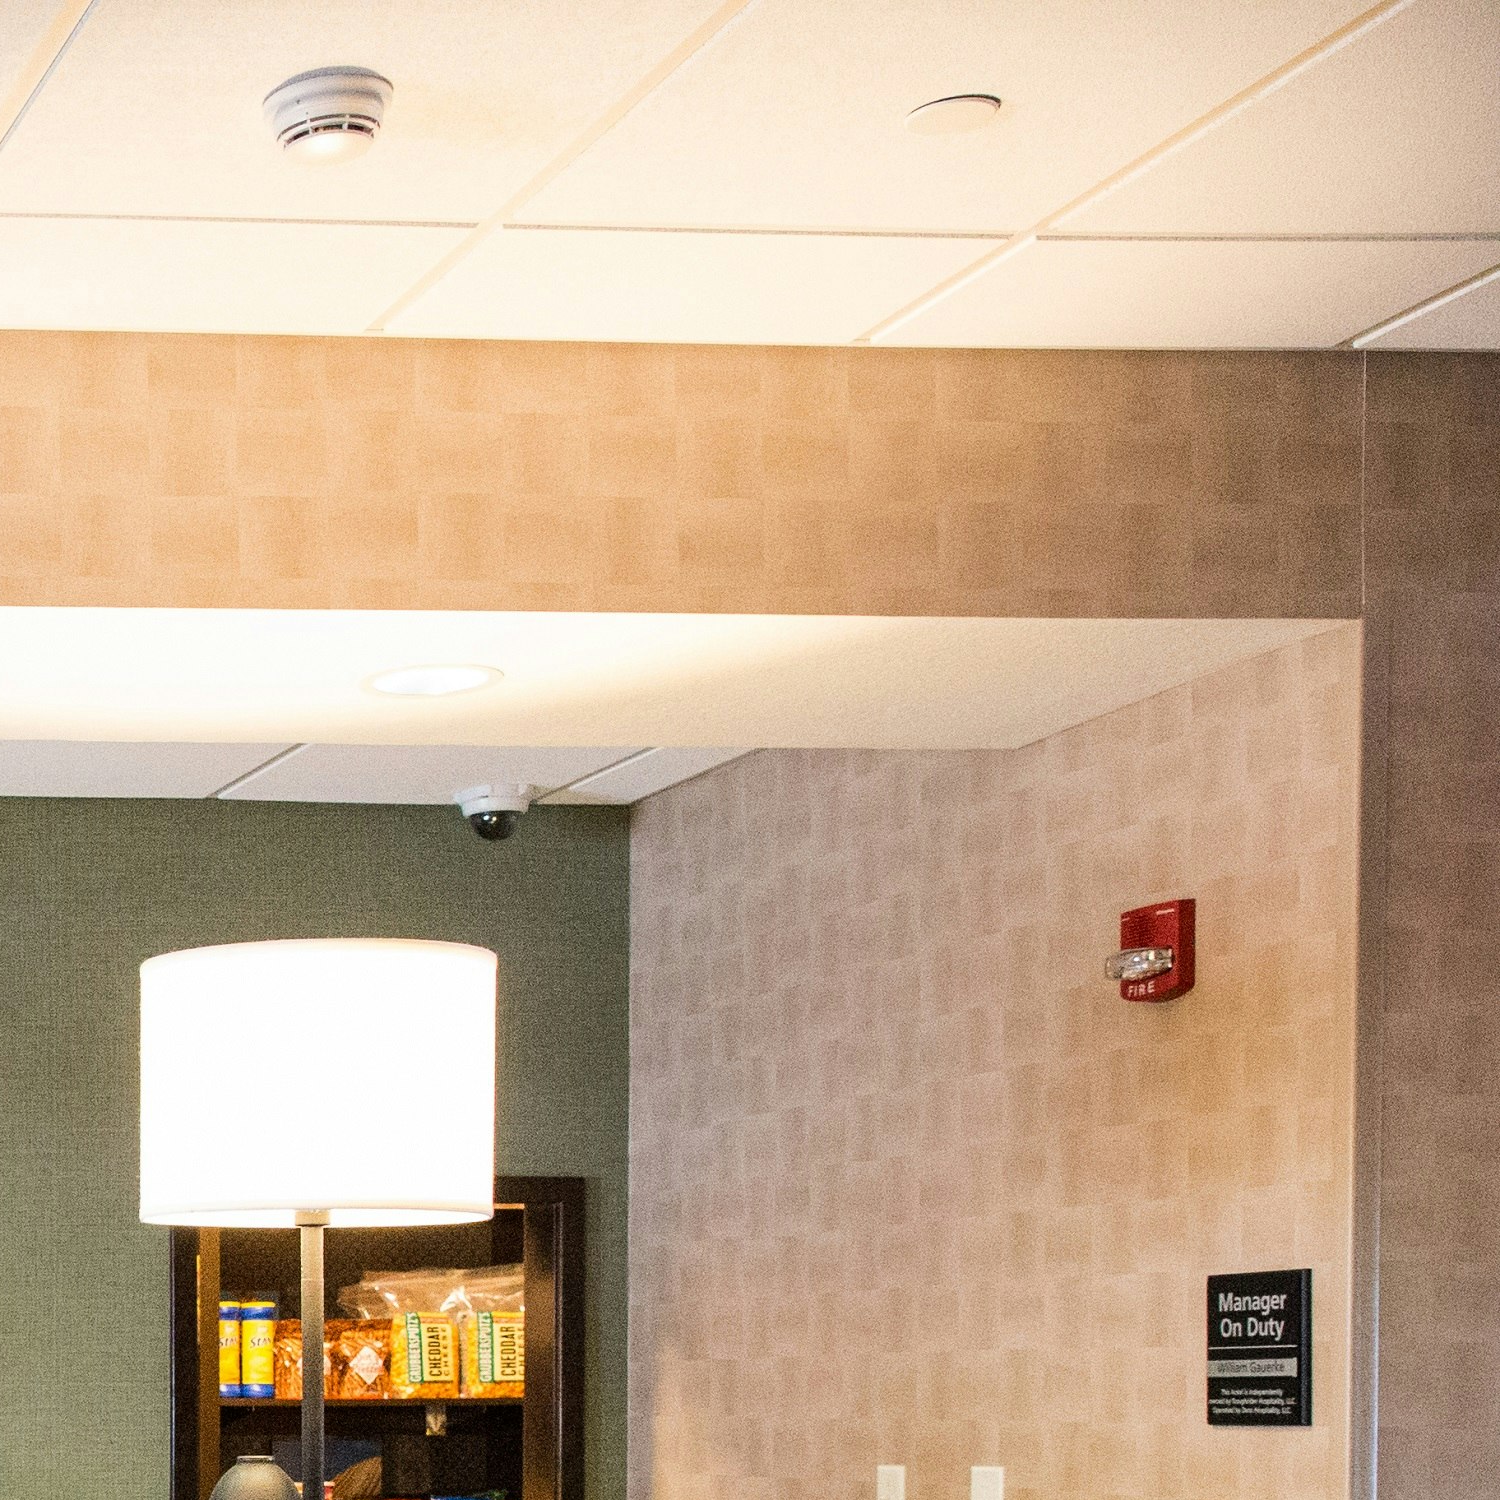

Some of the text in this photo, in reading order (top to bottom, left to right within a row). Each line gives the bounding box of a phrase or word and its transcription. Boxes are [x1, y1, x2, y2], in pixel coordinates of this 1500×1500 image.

[1128, 981, 1155, 997] FIRE
[1218, 1292, 1287, 1315] Manager
[1221, 1317, 1285, 1341] On Duty
[426, 1326, 443, 1377] CHEDDAR
[441, 1326, 450, 1377] CHEESE
[499, 1326, 517, 1377] CHEDDAR
